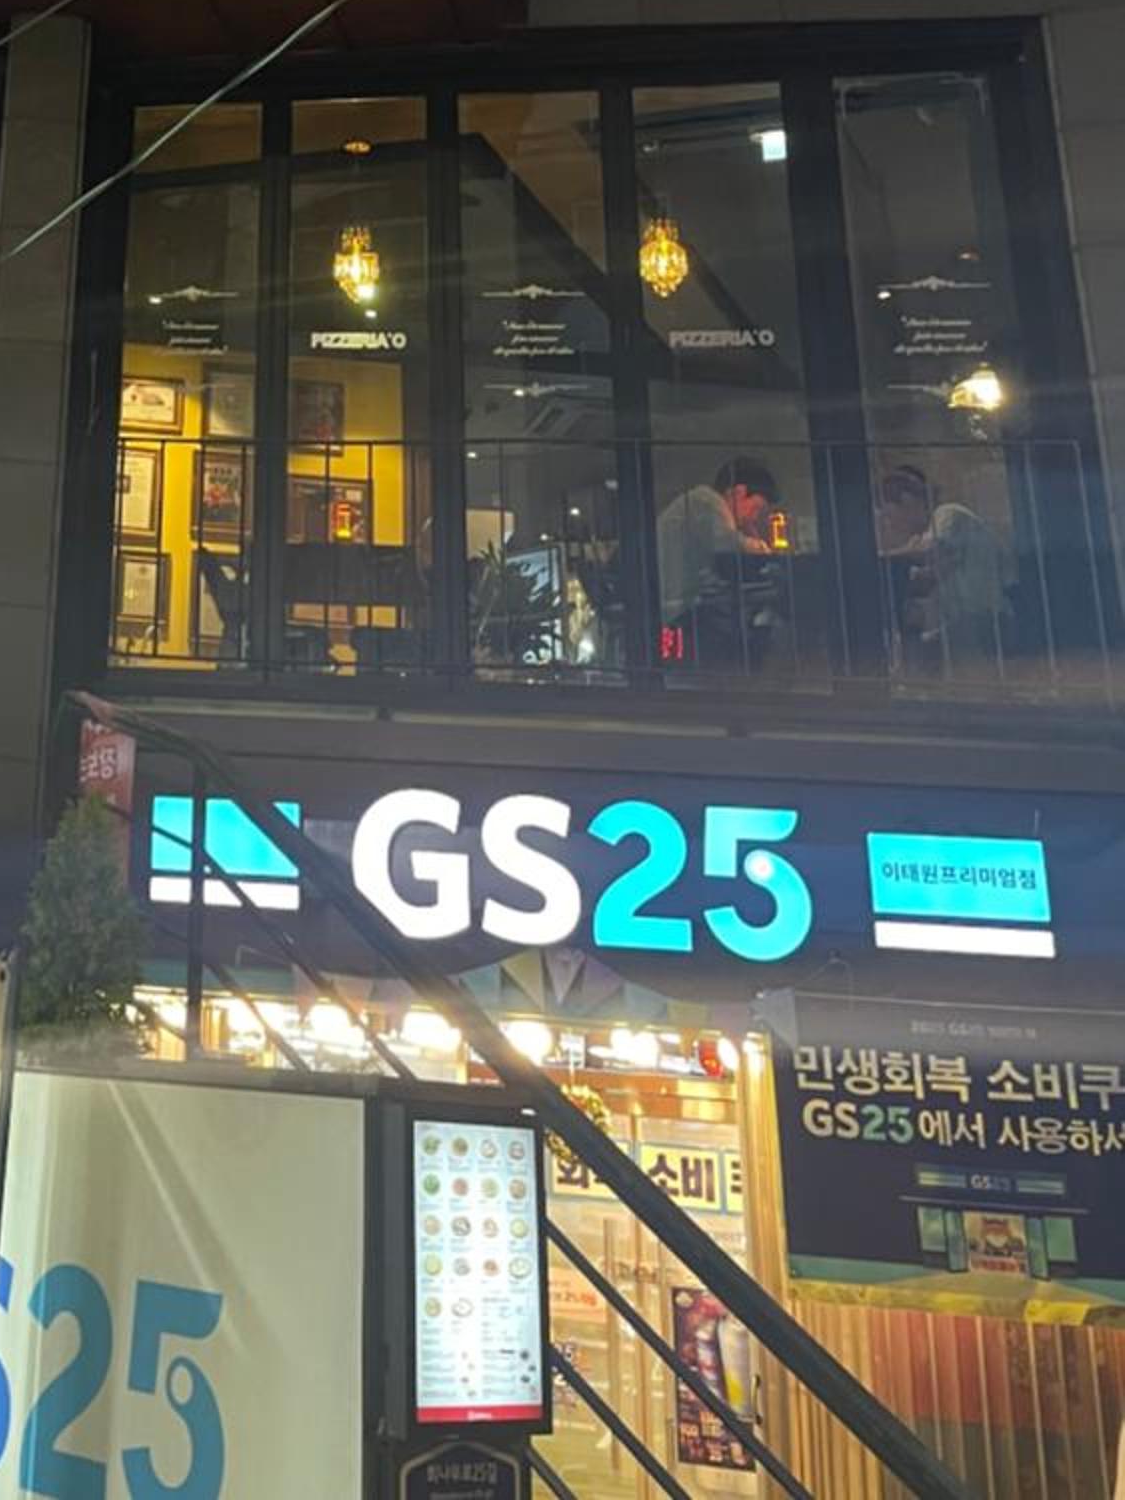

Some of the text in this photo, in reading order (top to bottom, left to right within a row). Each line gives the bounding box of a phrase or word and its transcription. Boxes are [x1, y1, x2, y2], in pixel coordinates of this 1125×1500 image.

[352, 788, 813, 962] GS25
[882, 861, 1037, 890] 이태원프리미엄점
[793, 1045, 972, 1104] 민생회복
